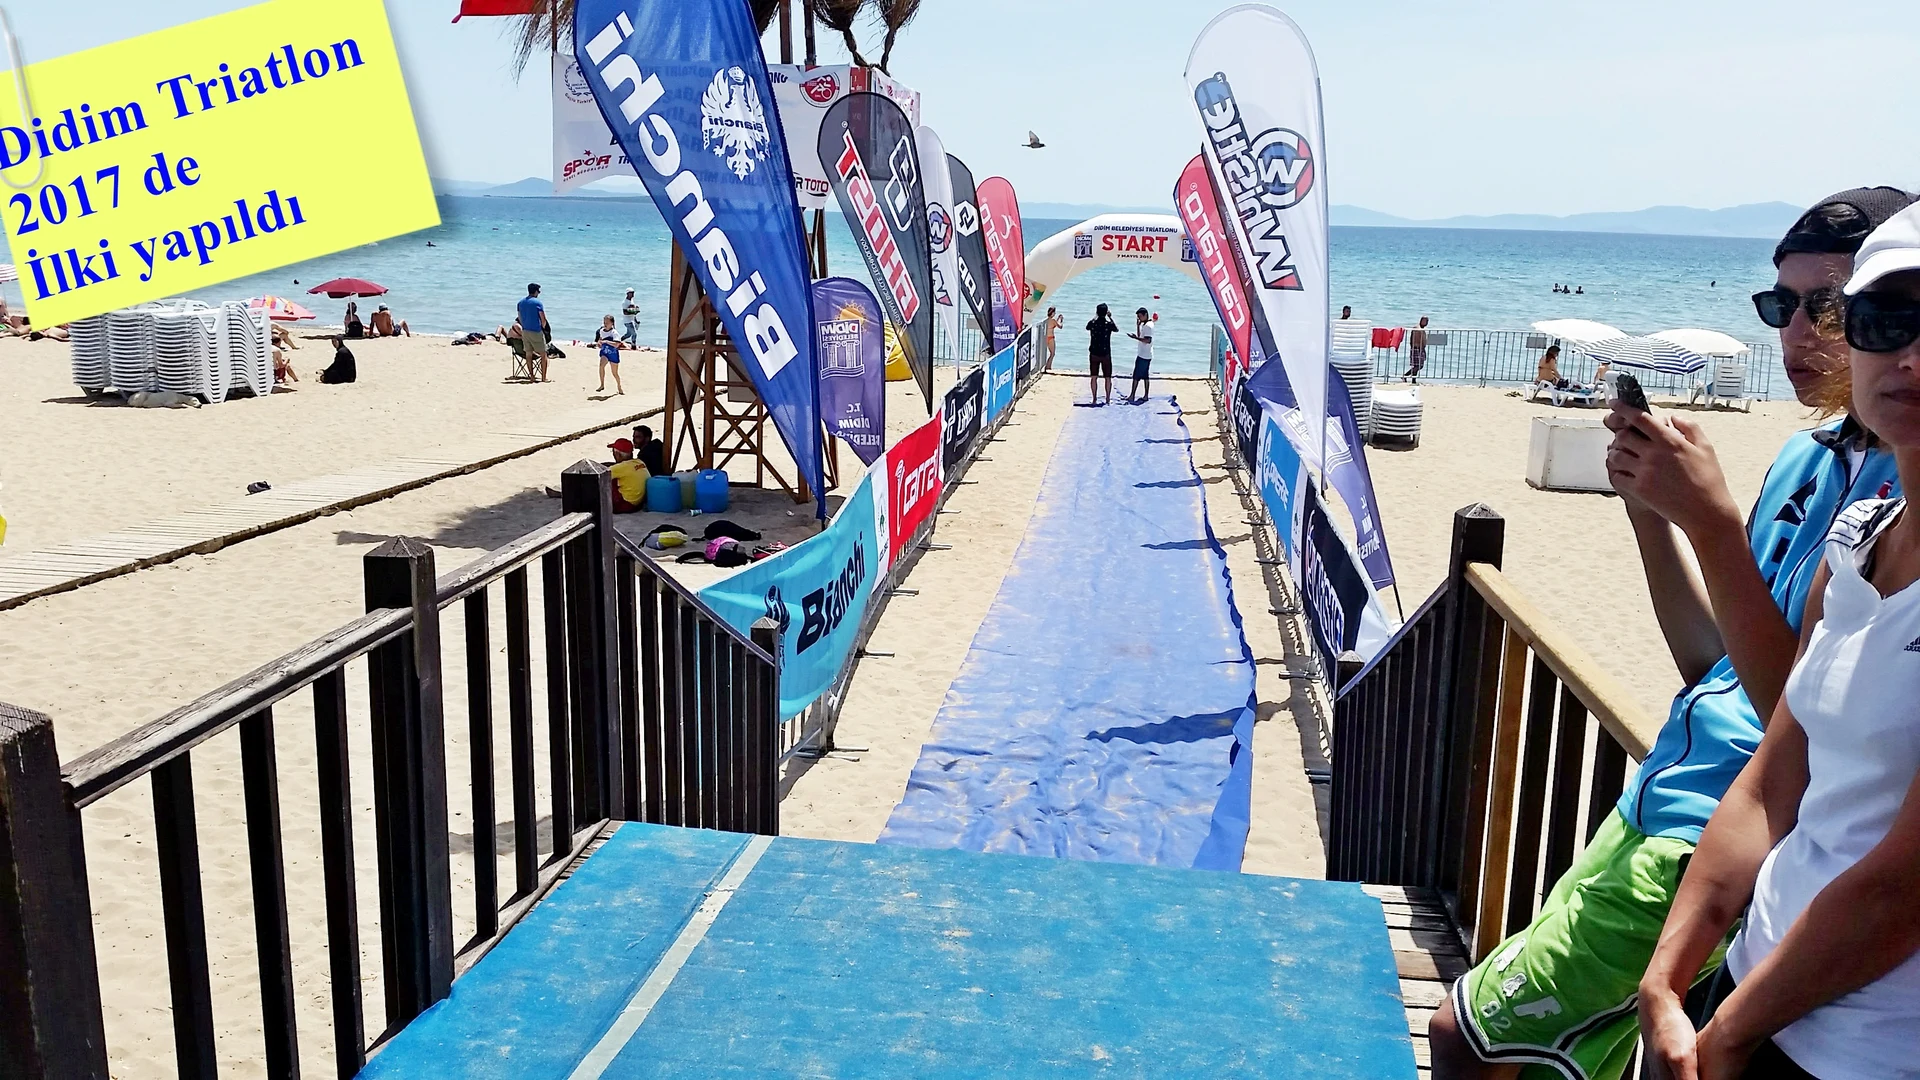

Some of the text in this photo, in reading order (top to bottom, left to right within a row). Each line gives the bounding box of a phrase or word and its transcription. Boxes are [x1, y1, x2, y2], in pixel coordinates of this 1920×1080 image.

[563, 155, 612, 176] SPOR
[805, 178, 829, 193] TOTO
[1102, 234, 1168, 252] START
[796, 531, 865, 655] Bianchi
